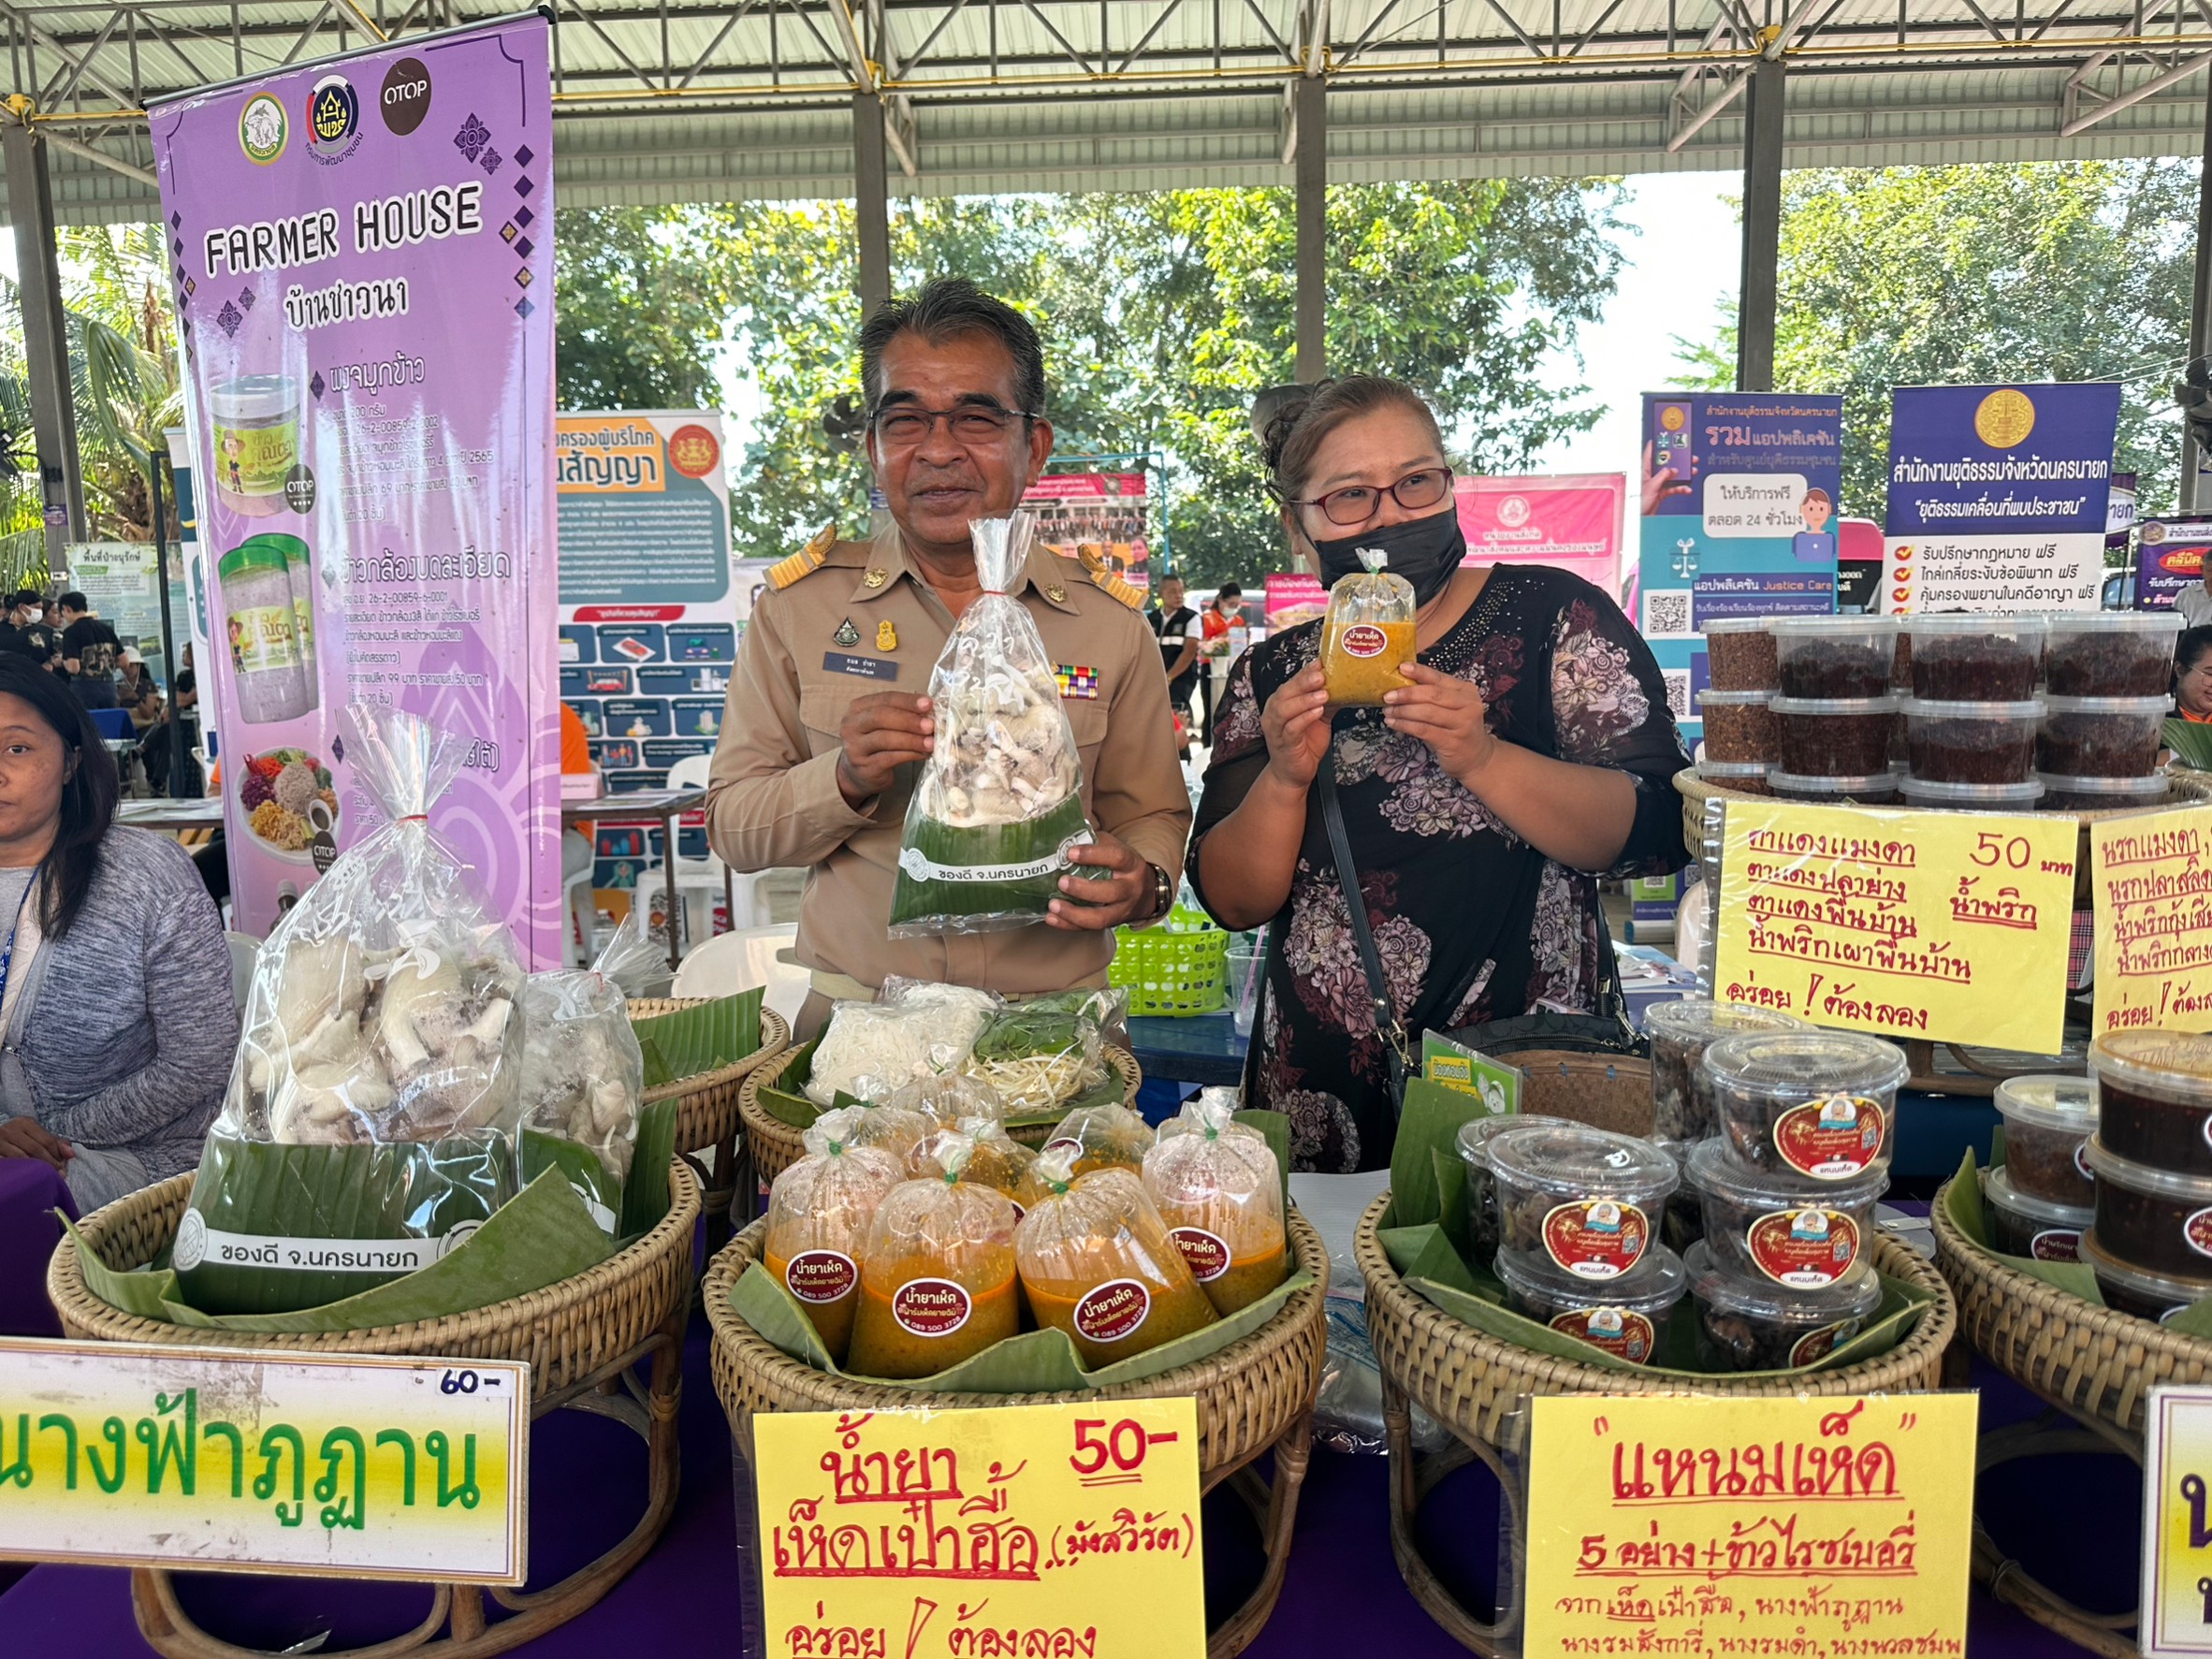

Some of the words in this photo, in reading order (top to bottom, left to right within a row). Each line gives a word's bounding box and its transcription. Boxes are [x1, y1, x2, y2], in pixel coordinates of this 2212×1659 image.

[384, 80, 428, 105] OTOP
[206, 212, 338, 275] FARMER
[356, 183, 481, 251] HOUSE
[285, 279, 407, 328] บ้านชาวนา
[1705, 426, 1752, 446] รวม
[1752, 429, 1836, 446] แอปพลิเคชัน
[469, 450, 494, 464] 2565
[1893, 454, 2108, 489] สำนักงานยุติธรรมจังหวัดนครนายก
[286, 480, 314, 493] OTOP
[1720, 485, 1791, 501] ให้บริการฟรี
[1708, 517, 1739, 527] ตลอด
[1747, 515, 1761, 527] 24
[1765, 506, 1803, 527] ชั่วโมง
[83, 548, 141, 565] พื้นที่ป่าอนุรักษ์
[342, 546, 511, 583] ข้าวกล้องบดละเอียด
[1923, 546, 2030, 563] รับปรึกษากฎหมาย
[2036, 543, 2057, 560] ฟรี
[1921, 561, 2053, 581] ไกล่เกลี่ยระงับข้อพิพาท
[2058, 562, 2079, 578] ฟรี
[1694, 578, 1759, 591] แอปพลิเคชัน
[1763, 580, 1804, 591] Justice
[1808, 579, 1833, 590] Care
[1920, 584, 2073, 605] คุ้มครองพยานในคดีอาญา
[2077, 583, 2096, 600] ฟรี
[313, 845, 336, 858] OTOP
[1969, 832, 2031, 869] 50
[2040, 859, 2074, 877] บาท
[938, 866, 972, 880] ของดี
[976, 864, 1049, 880] จ.นครนายก
[1949, 876, 2038, 924] น้ำพริก
[1725, 969, 1792, 1010] อร่อย
[1824, 982, 1928, 1031] ต้องลอง
[2107, 992, 2153, 1030] อร่อย
[220, 1243, 279, 1264] ของดี
[287, 1249, 418, 1268] จ.นครนายก
[795, 1258, 843, 1274] น้ำยาเห็ด
[905, 1286, 956, 1304] น้ำยาเห็ด
[1084, 1288, 1133, 1318] น้ำยาเห็ด
[440, 1368, 502, 1394] 60-
[0, 1387, 481, 1530] นางฟ้าภูฏาน
[820, 1412, 958, 1496] น้ำยา
[1070, 1418, 1179, 1476] 50-
[1577, 1534, 1607, 1569] 5
[784, 1599, 887, 1658] อร่อย
[948, 1597, 1098, 1658] ต้องลอง
